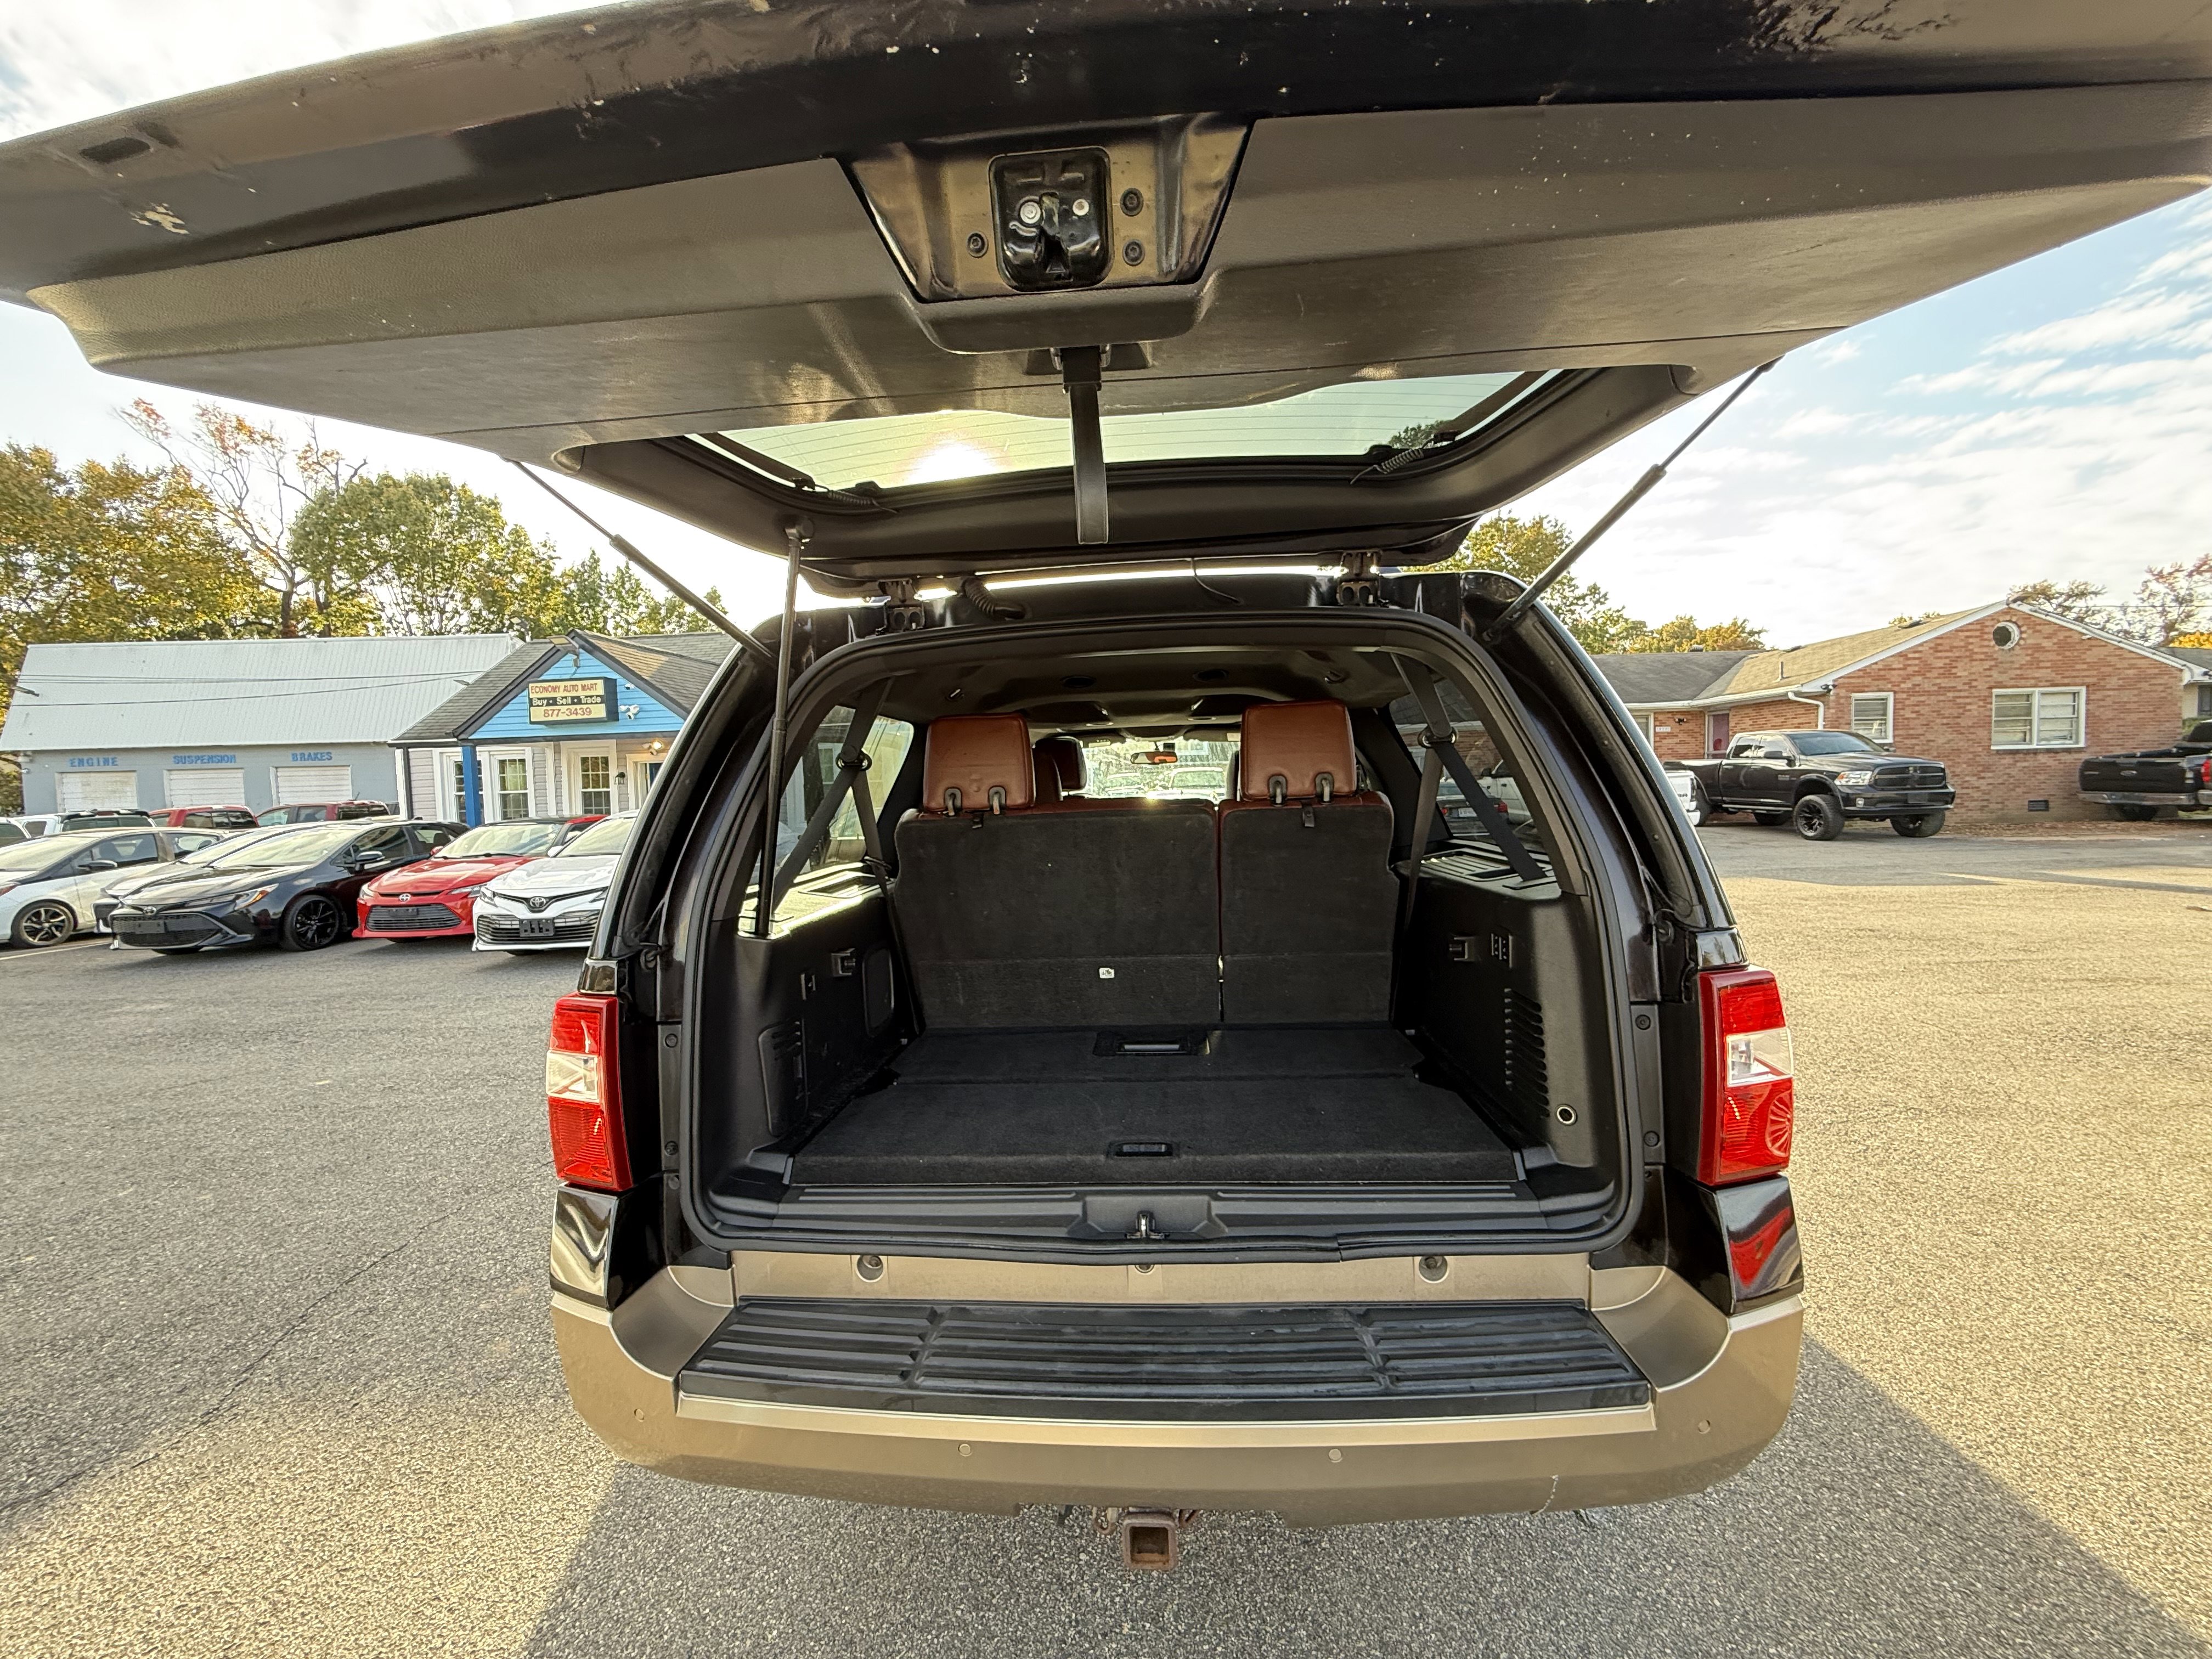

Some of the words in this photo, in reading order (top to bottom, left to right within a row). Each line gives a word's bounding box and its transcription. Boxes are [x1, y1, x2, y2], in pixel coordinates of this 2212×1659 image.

[531, 685, 560, 693] ECONOMY
[563, 684, 579, 692] AUTO
[581, 683, 597, 691] MART
[532, 698, 547, 707] Buy
[580, 696, 601, 704] Trade
[173, 754, 236, 764] SUSPENSION
[291, 752, 332, 761] BRAKES
[70, 757, 119, 767] ENGINE
